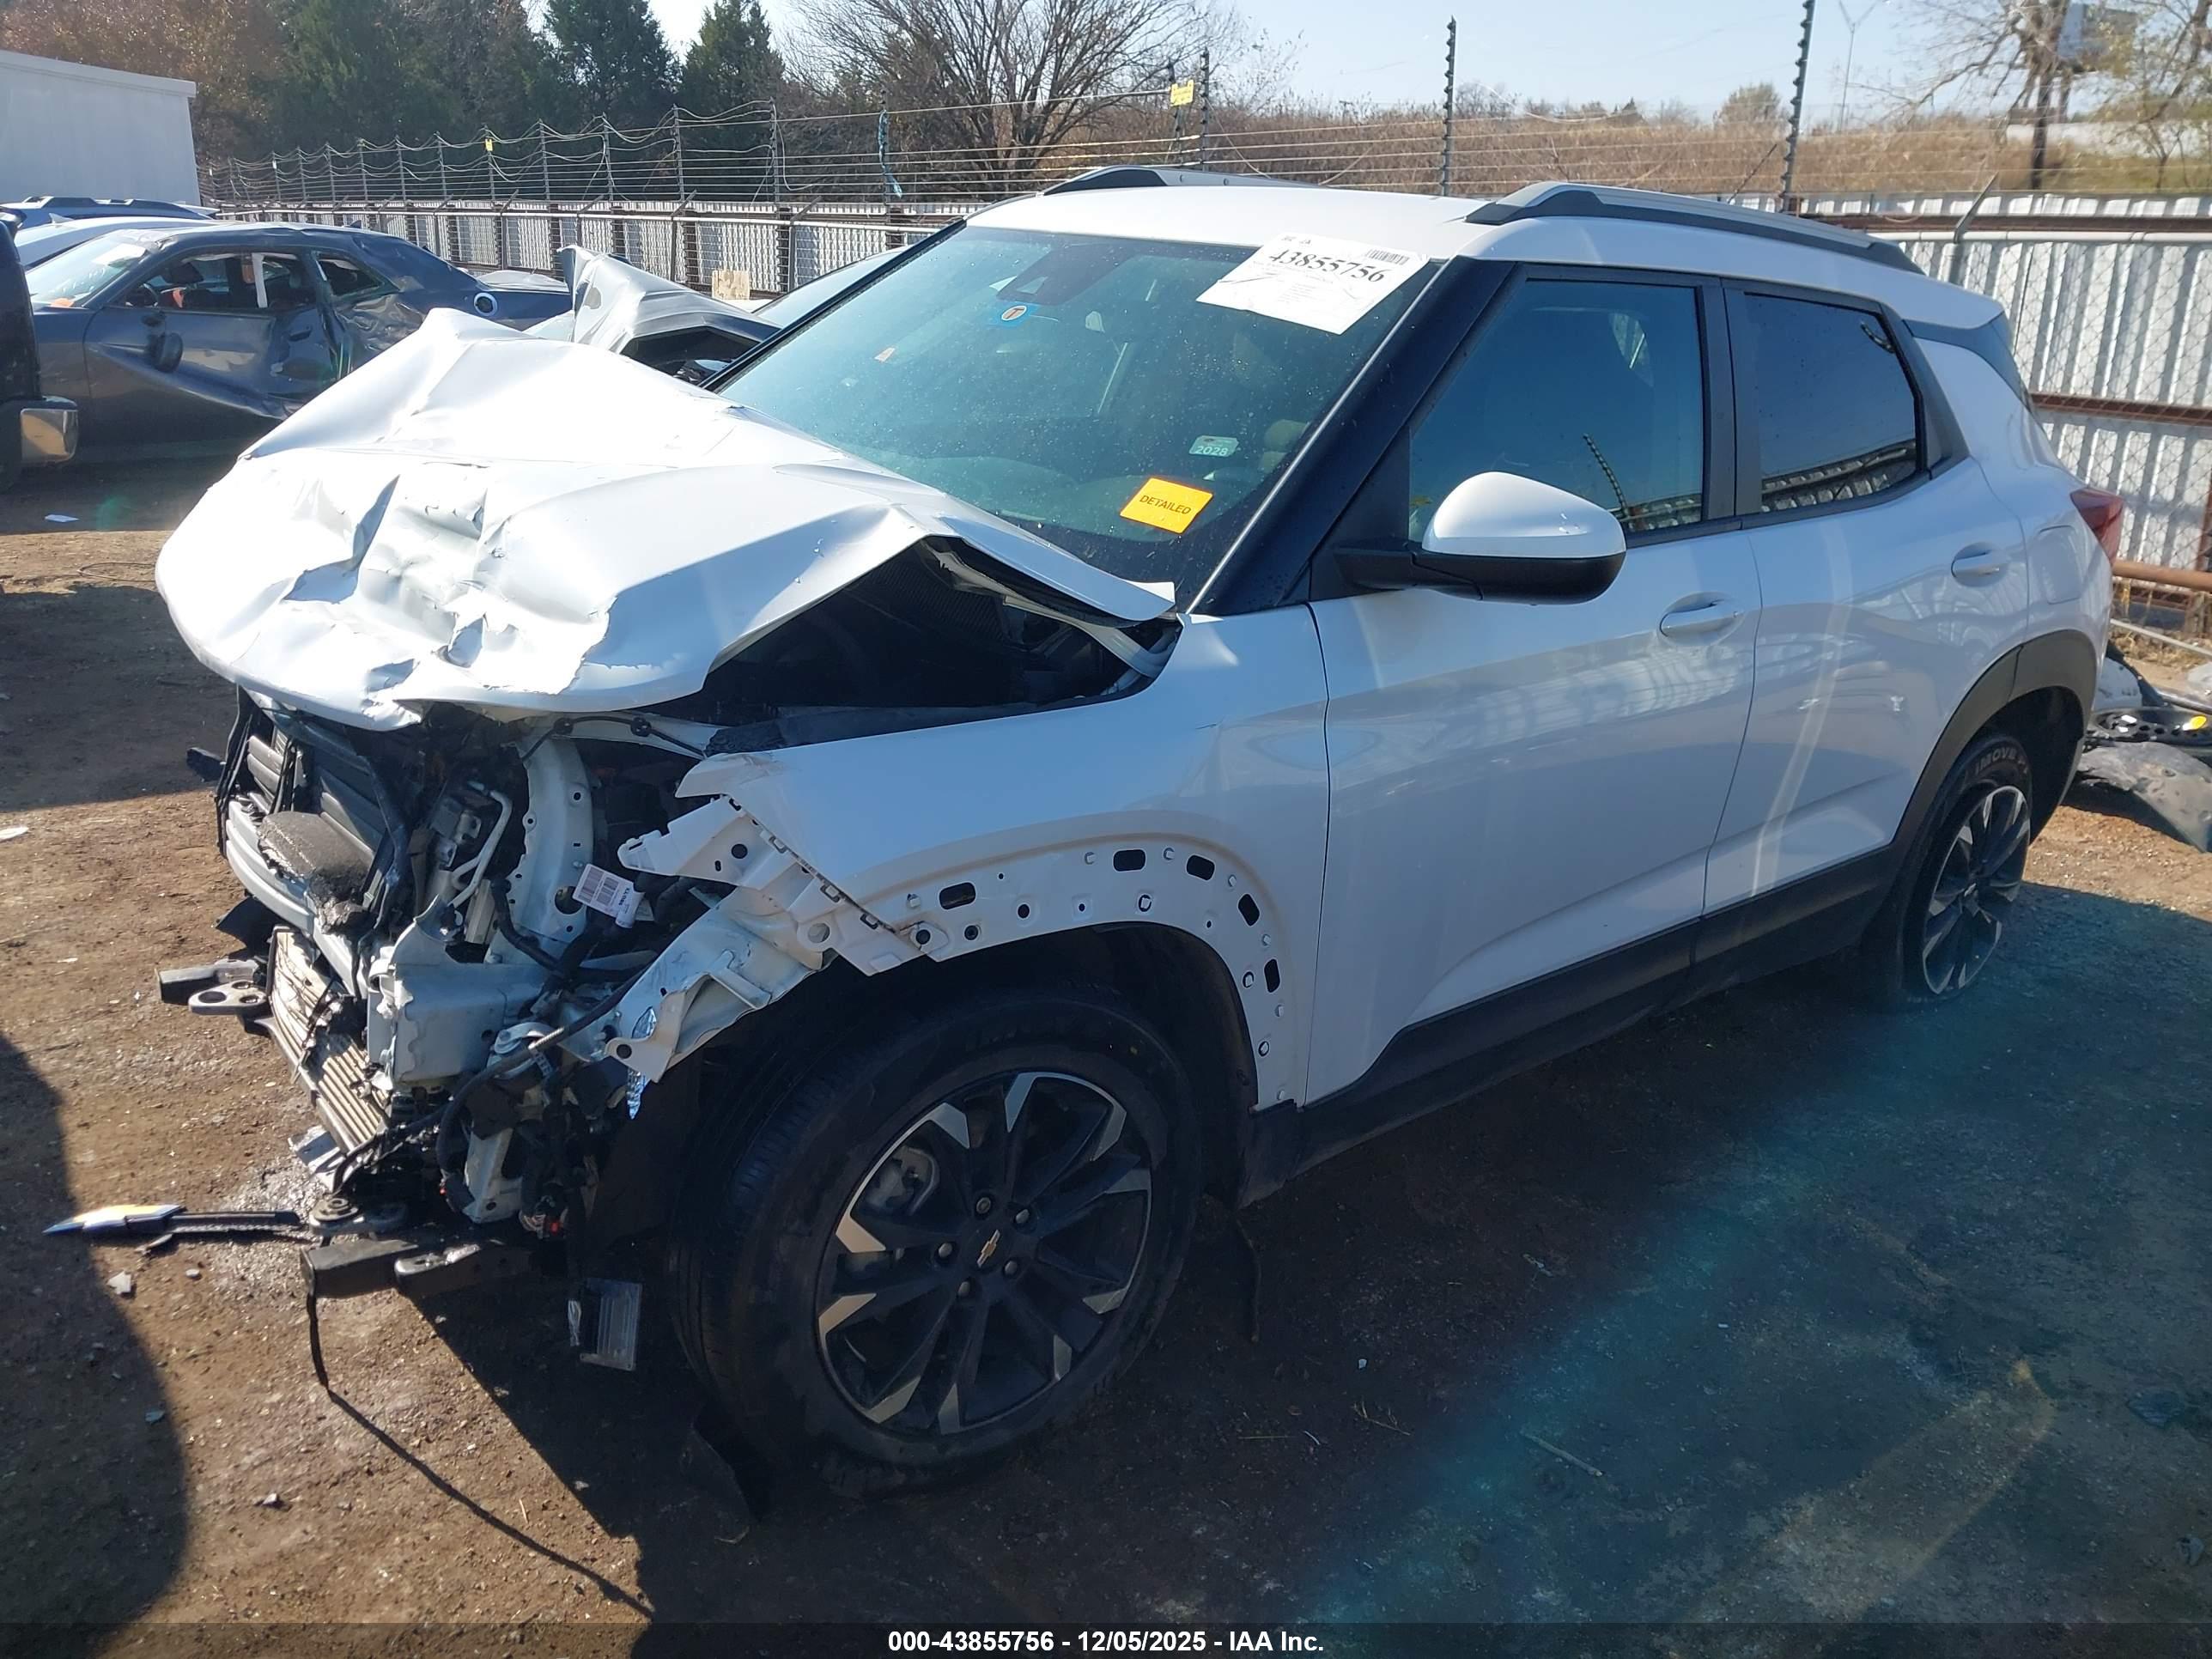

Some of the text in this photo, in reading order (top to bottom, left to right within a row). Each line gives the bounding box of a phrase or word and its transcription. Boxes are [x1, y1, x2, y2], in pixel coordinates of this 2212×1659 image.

[1268, 248, 1391, 282] 43855756
[1195, 446, 1229, 456] 2028
[1139, 495, 1191, 515] DETAILED
